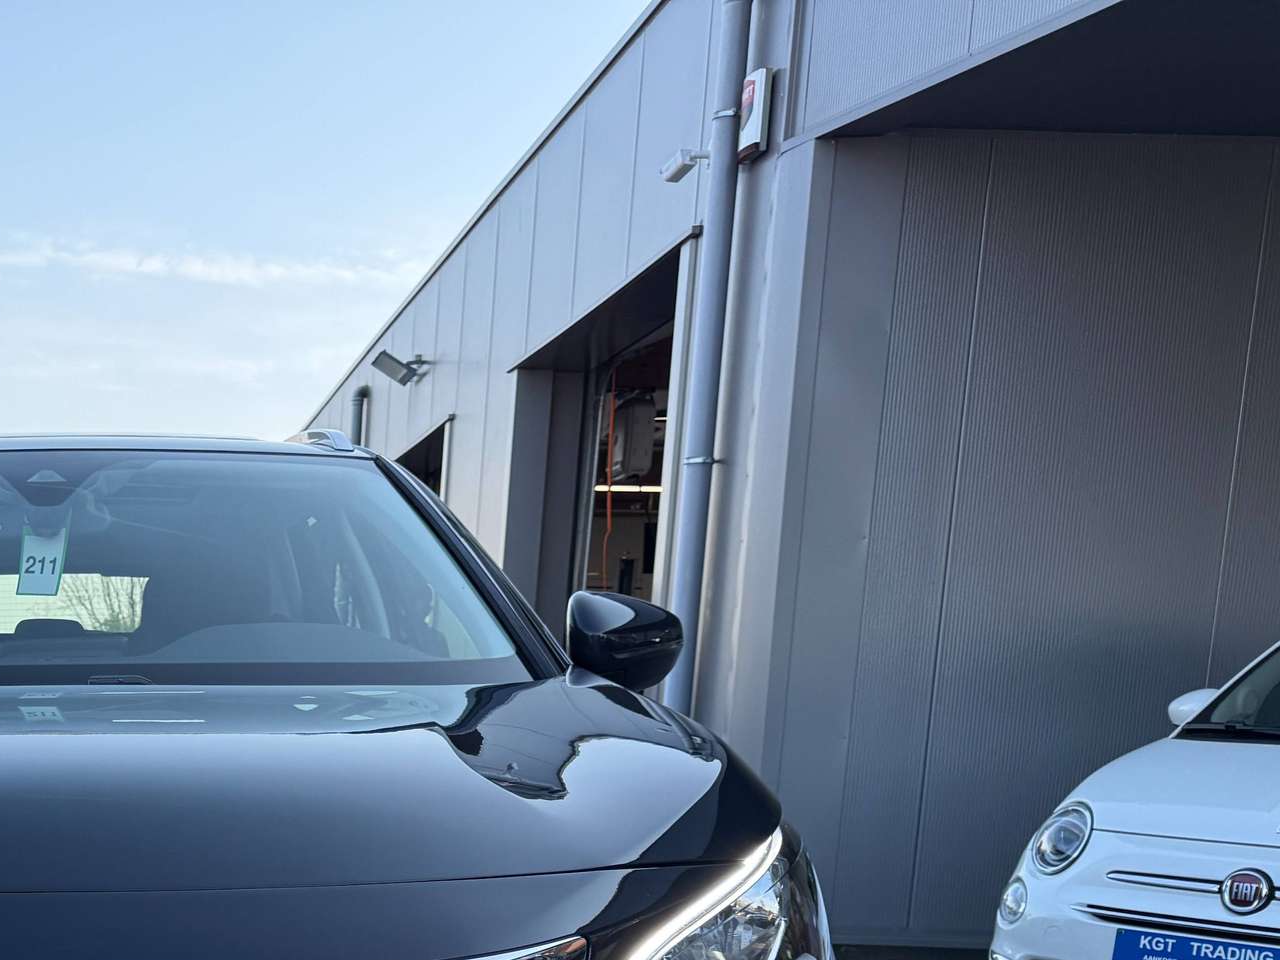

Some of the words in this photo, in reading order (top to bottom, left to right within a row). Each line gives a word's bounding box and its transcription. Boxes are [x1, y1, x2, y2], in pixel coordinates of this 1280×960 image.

[23, 555, 58, 575] 211
[1231, 881, 1259, 901] FIAT
[1139, 935, 1176, 953] KGT
